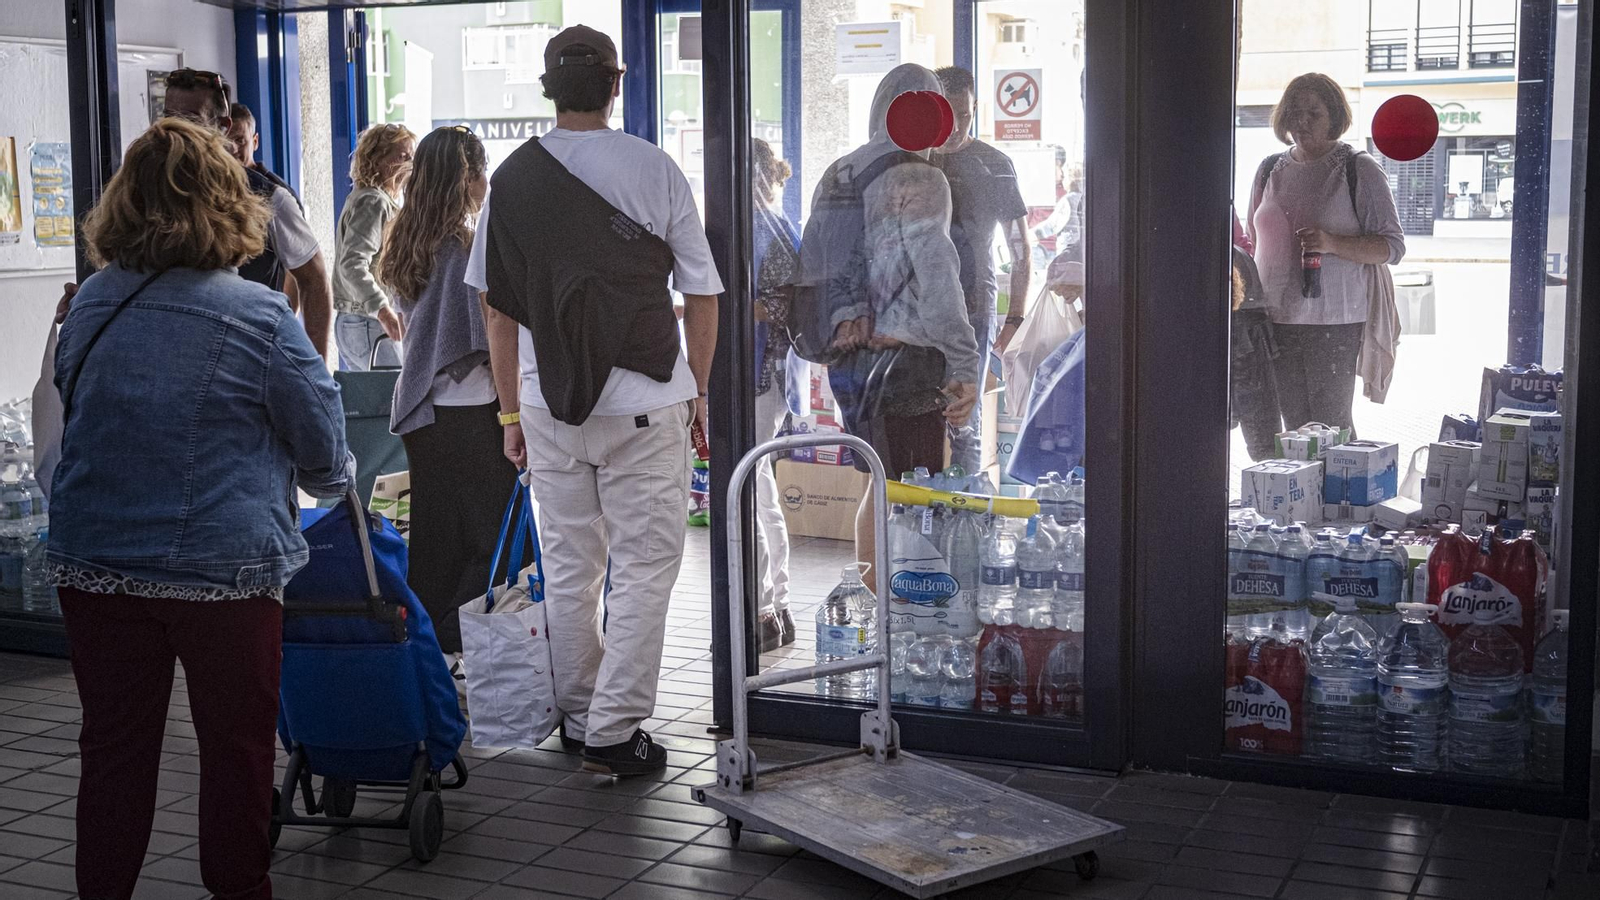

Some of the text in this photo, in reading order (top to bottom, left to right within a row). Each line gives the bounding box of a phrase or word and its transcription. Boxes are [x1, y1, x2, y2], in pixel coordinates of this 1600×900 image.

[1438, 111, 1482, 124] WERK
[1333, 458, 1357, 466] ENTERA
[1289, 477, 1298, 490] EN
[1289, 487, 1305, 502] TERA
[894, 578, 953, 593] aquaBona
[1236, 579, 1280, 595] DEHESA
[1330, 583, 1375, 597] DEHESA
[1225, 698, 1287, 720] anjarón
